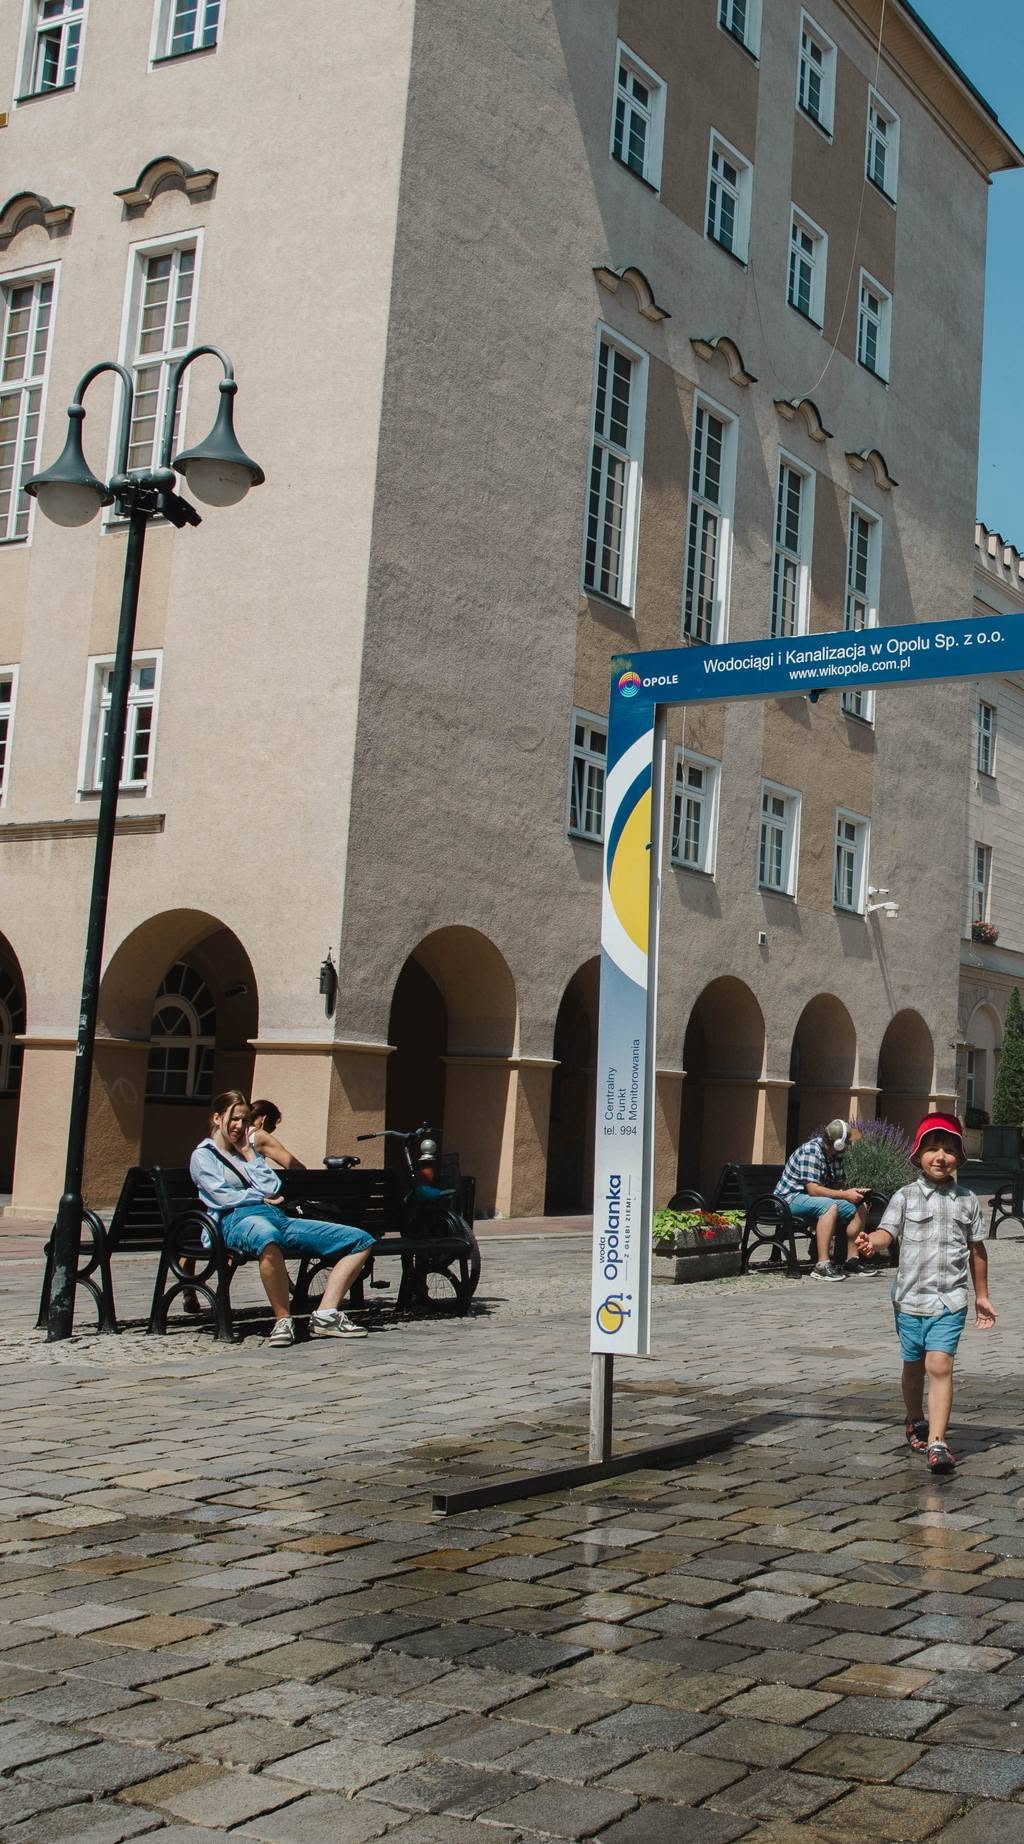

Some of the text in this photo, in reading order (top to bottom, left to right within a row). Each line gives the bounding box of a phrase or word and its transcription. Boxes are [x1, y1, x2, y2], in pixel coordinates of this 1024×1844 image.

[703, 630, 1006, 674] Wodociągi i Kanalizacja w Opolu Sp. z o.o.
[788, 656, 911, 681] www.wikopole.com.pl
[642, 673, 679, 688] OPOLE
[604, 1066, 618, 1121] Centralny
[628, 1039, 641, 1121] Monitorowania
[616, 1088, 627, 1121] Punkt
[603, 1125, 638, 1136] tel. 994
